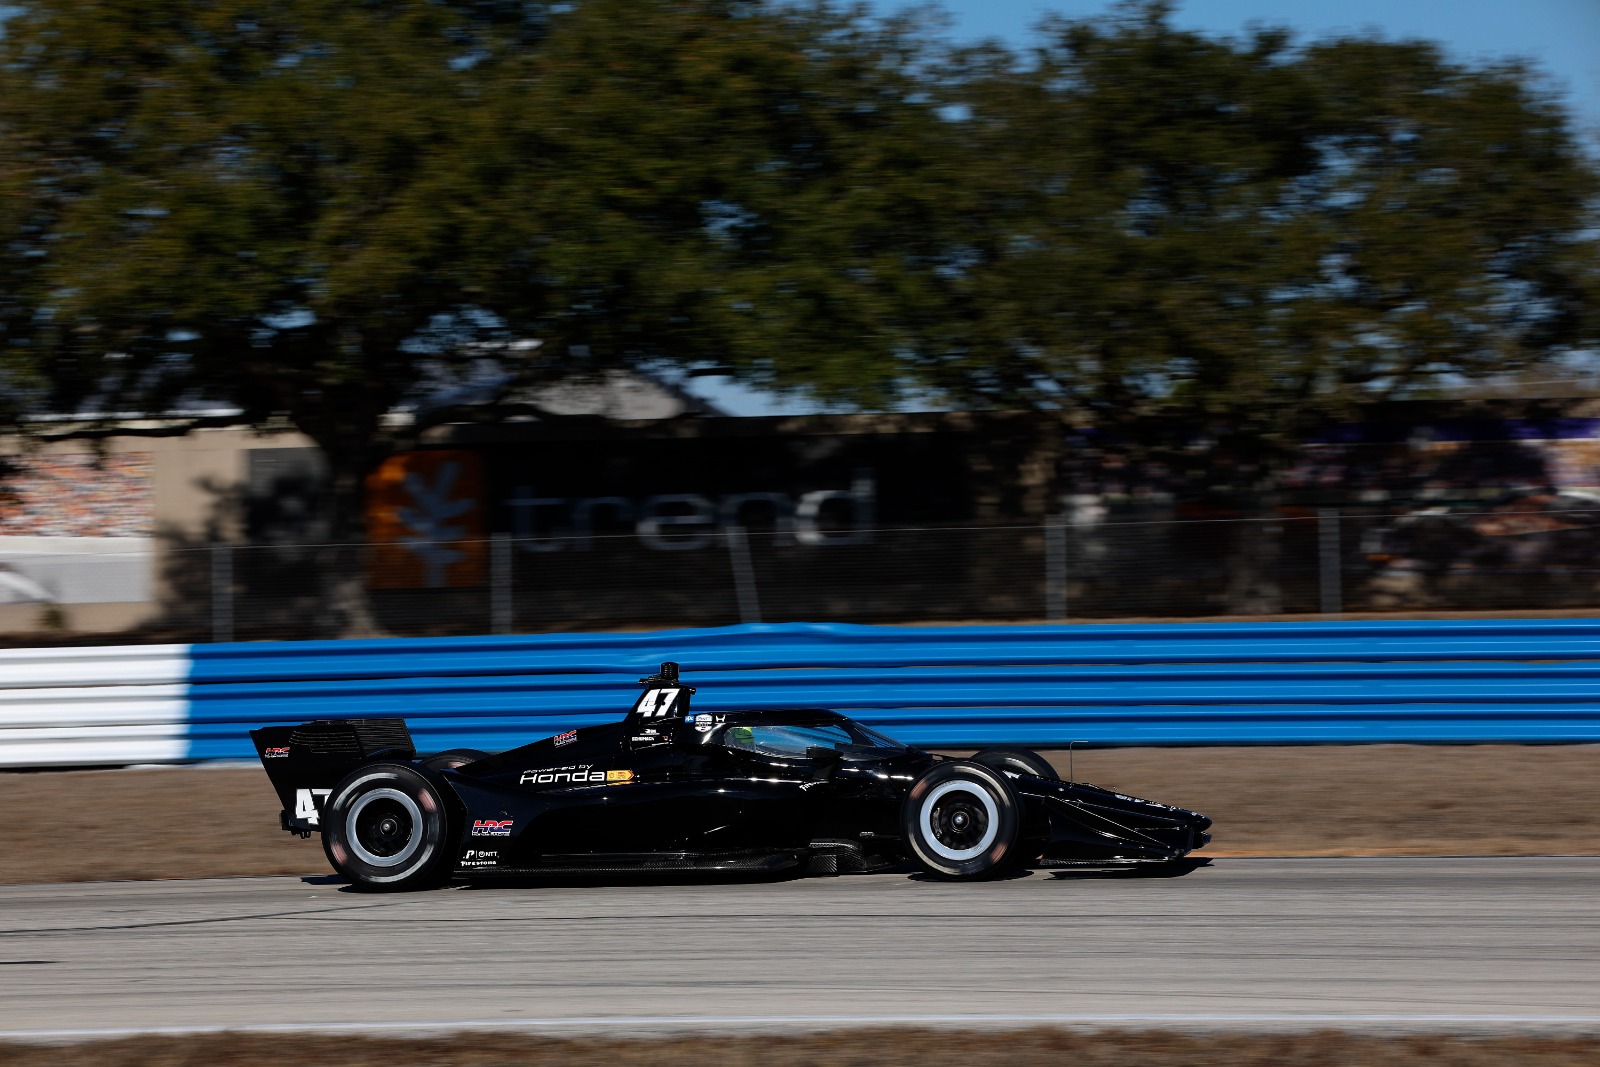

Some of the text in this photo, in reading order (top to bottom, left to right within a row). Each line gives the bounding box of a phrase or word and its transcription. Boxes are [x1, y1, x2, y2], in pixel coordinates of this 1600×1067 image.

[506, 468, 875, 551] trend
[636, 688, 681, 717] 47
[520, 770, 605, 785] Honda
[472, 820, 513, 833] HRC
